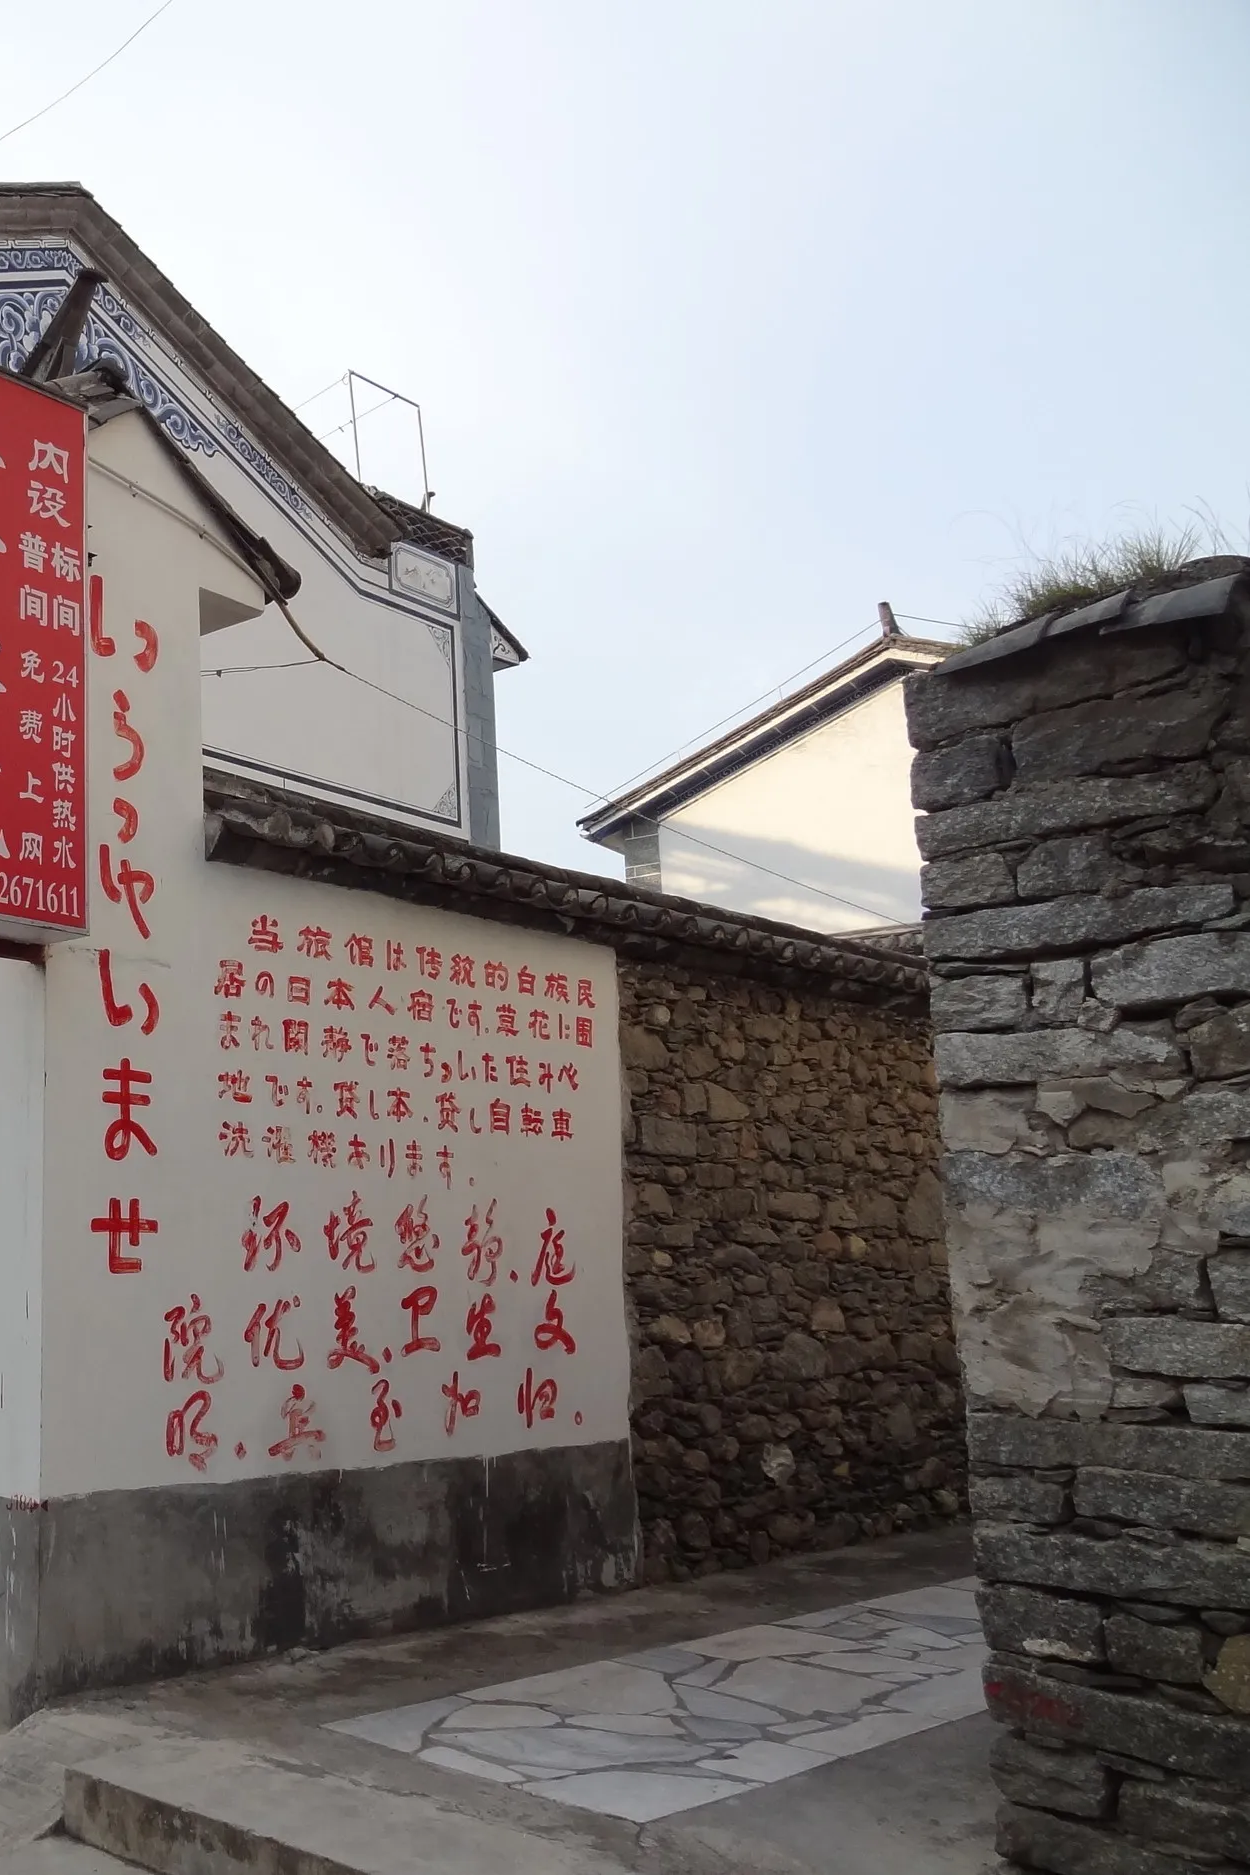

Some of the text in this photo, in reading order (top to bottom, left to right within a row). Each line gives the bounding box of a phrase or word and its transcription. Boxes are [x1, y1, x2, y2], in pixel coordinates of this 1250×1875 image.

[28, 439, 70, 529] 内设
[18, 531, 48, 629] 普间
[51, 540, 81, 637] 标间
[19, 649, 45, 865] 免费上网
[51, 660, 79, 870] 24小时供热水
